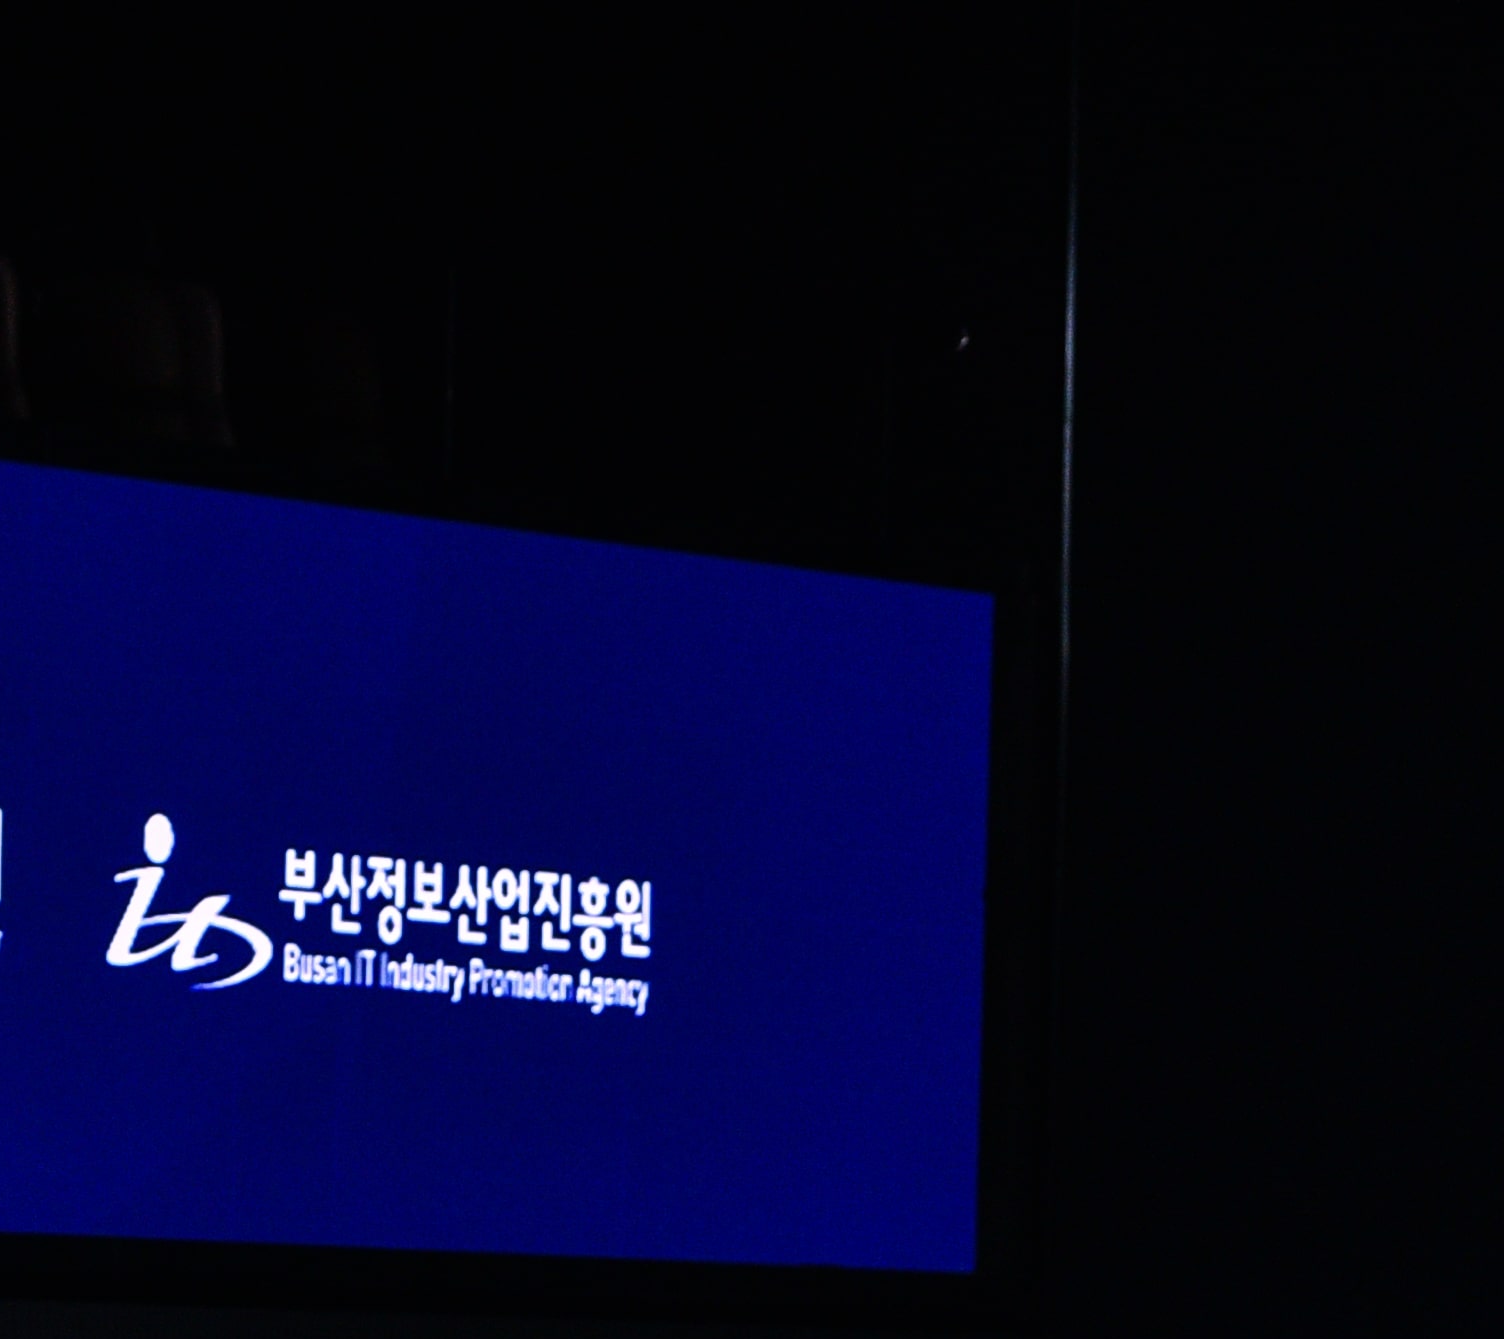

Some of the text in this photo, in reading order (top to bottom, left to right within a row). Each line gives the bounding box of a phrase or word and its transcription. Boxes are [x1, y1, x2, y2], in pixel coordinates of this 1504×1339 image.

[278, 848, 652, 961] 부산정보산업진흥원
[283, 943, 649, 1016] Busan IT Industry Promotion Agency
